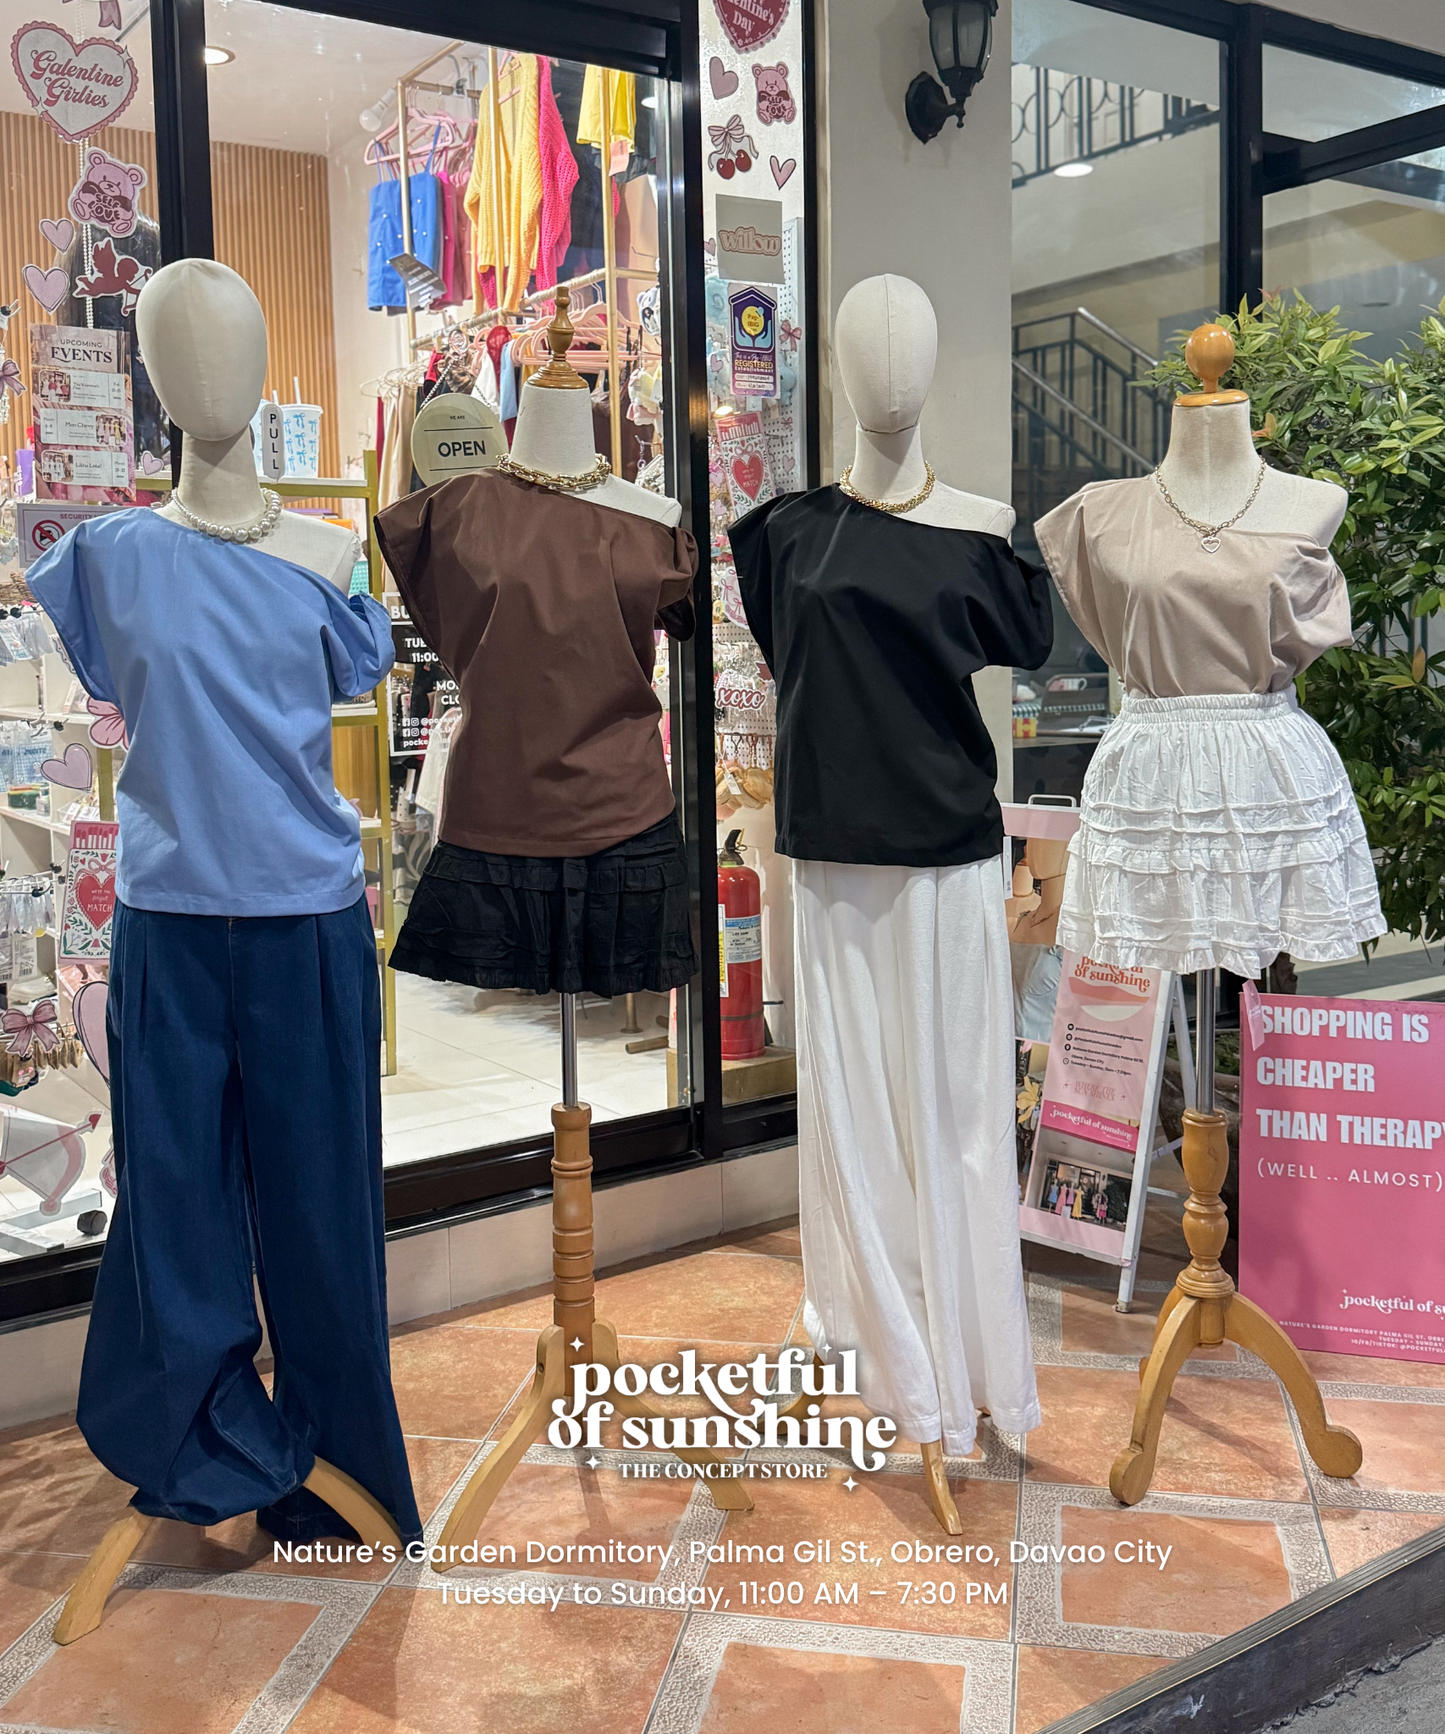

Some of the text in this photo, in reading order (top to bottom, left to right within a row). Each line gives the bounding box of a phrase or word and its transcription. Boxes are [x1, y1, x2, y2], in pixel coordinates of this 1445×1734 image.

[733, 10, 755, 37] Day
[29, 50, 124, 87] Galentine
[43, 77, 110, 108] Girlies
[767, 96, 782, 104] SELF
[766, 103, 787, 115] LOVE
[88, 200, 121, 220] LOVE
[95, 193, 120, 209] SELF
[60, 339, 102, 348] UPCOMING
[51, 346, 113, 363] EVENTS
[735, 359, 773, 369] REGISTERED
[269, 413, 280, 470] PULL
[438, 440, 486, 457] OPEN
[87, 903, 113, 912] MATCH
[1089, 969, 1151, 993] sunshine
[1261, 1005, 1429, 1043] SHOPPING IS
[1256, 1056, 1375, 1092] CHEAPER
[1050, 1109, 1092, 1126] pocketful
[1092, 1121, 1101, 1129] of
[1256, 1108, 1445, 1150] THAN THERAP
[1257, 1157, 1318, 1180] (WELL
[1348, 1169, 1443, 1192] ALMOST)
[1339, 1294, 1414, 1314] pocketful
[1416, 1300, 1434, 1313] of
[1312, 1323, 1338, 1331] GARDEN
[1339, 1326, 1378, 1335] DORMITORY
[1379, 1330, 1402, 1338] PALMA
[1379, 1336, 1408, 1344] TUESDAY
